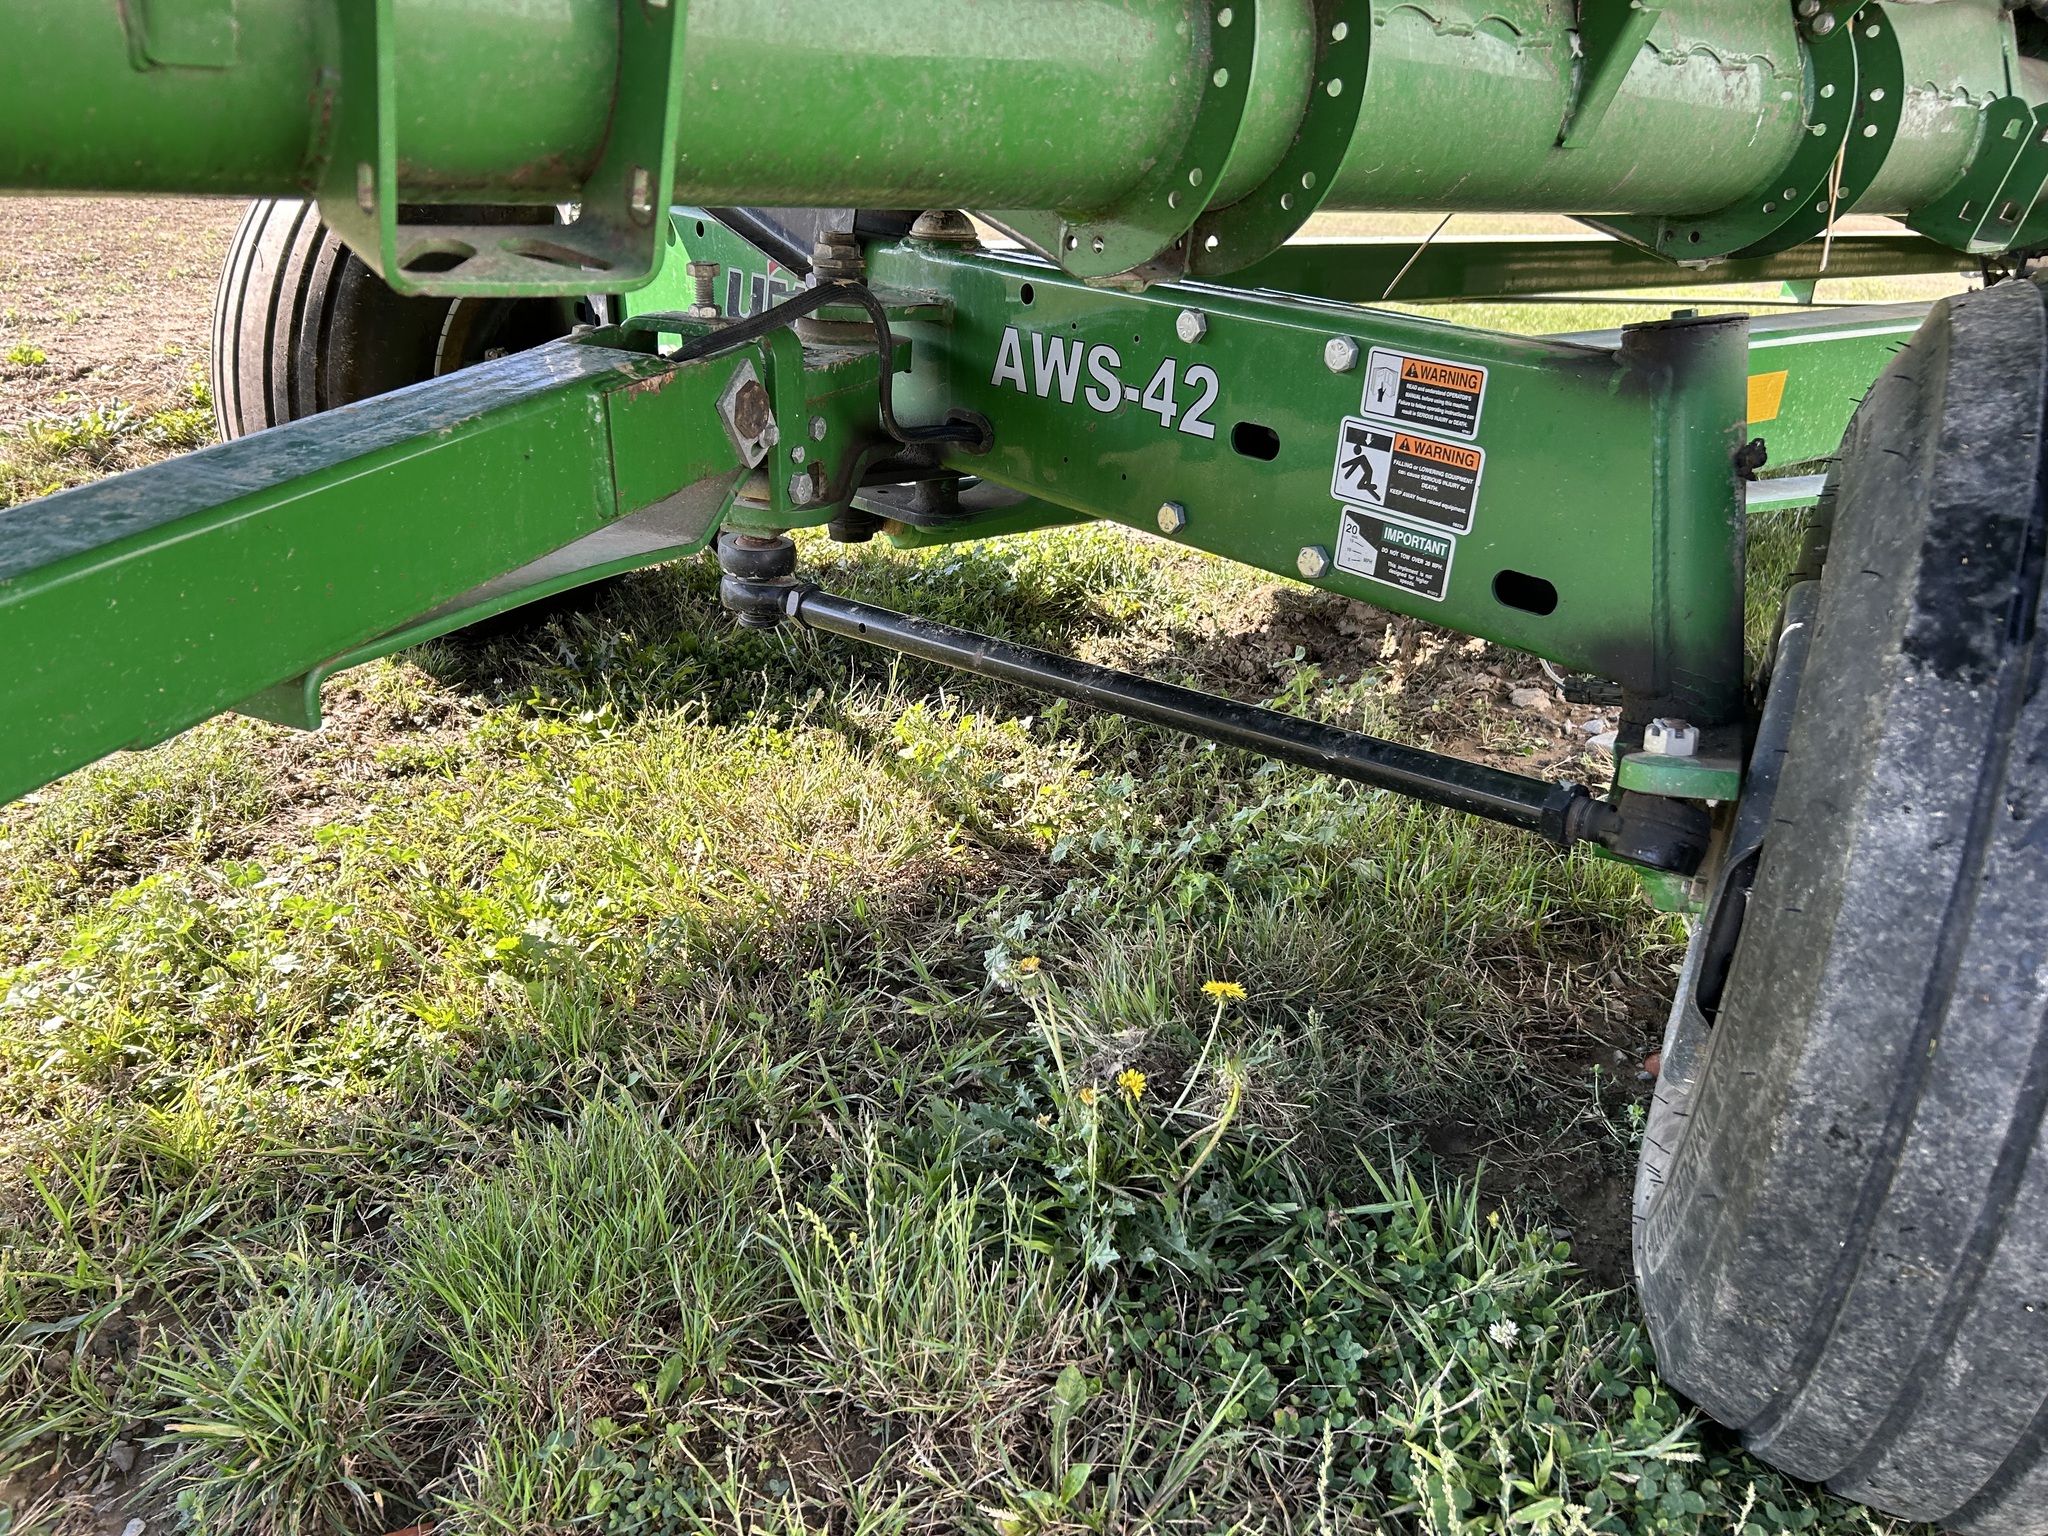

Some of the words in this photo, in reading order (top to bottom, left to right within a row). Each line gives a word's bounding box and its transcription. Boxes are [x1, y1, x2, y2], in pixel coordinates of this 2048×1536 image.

[990, 325, 1220, 440] AWS-42
[1421, 366, 1477, 389] WARNING
[1425, 388, 1446, 396] understand
[1417, 412, 1433, 420] SERIOUS
[1414, 441, 1474, 467] WARNING
[1393, 459, 1413, 469] FALLING
[1419, 466, 1444, 477] LOWERING
[1445, 472, 1473, 484] EQUIPMENT
[1421, 474, 1441, 485] SERIOUS
[1442, 480, 1459, 489] INJURY
[1389, 488, 1402, 496] KEEP
[1402, 491, 1416, 499] AWAY
[1416, 495, 1427, 503] from
[1427, 497, 1441, 507] raised
[1346, 524, 1358, 534] 20
[1384, 527, 1447, 556] IMPORTANT
[1398, 564, 1418, 575] implement
[1400, 552, 1411, 560] TOW
[1411, 556, 1423, 564] OVER
[1431, 562, 1443, 570] MPH.
[1389, 569, 1407, 578] designed
[1416, 576, 1429, 584] higher
